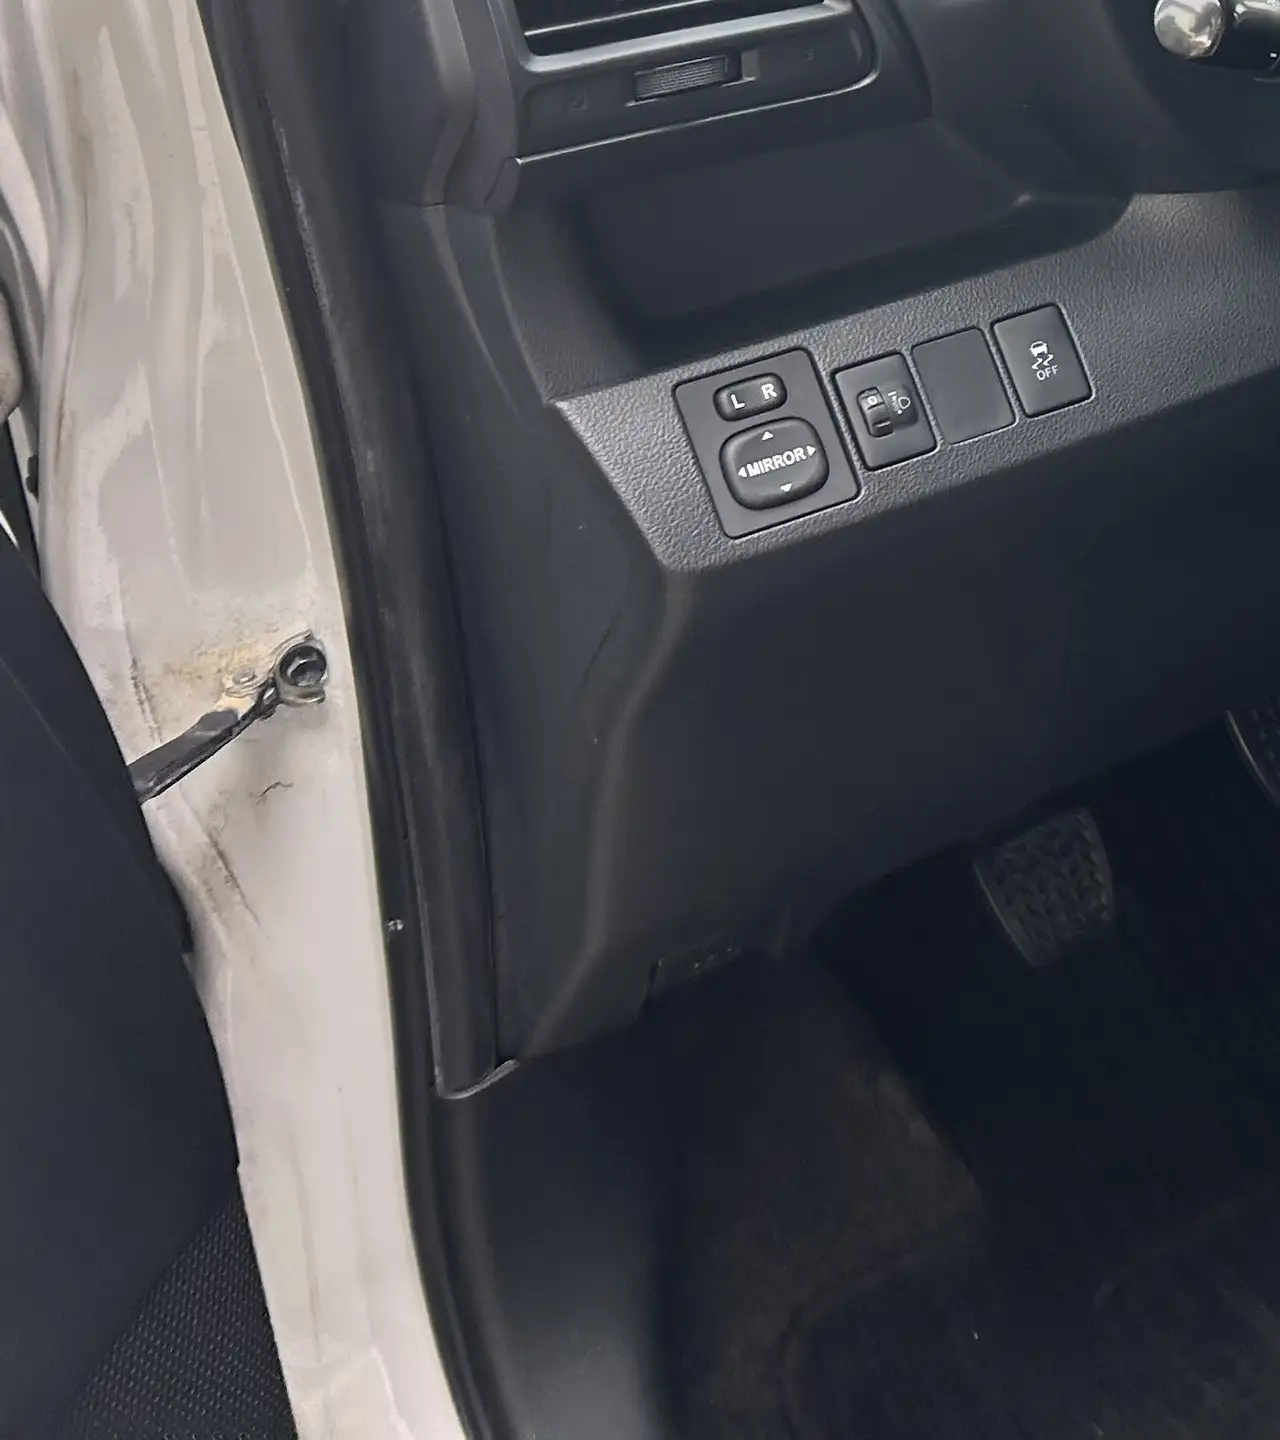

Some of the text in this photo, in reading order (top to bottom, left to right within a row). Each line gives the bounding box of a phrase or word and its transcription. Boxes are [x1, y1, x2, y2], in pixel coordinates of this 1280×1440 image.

[1035, 364, 1059, 381] OFF
[730, 383, 777, 410] L R
[746, 447, 806, 478] MIRROR
